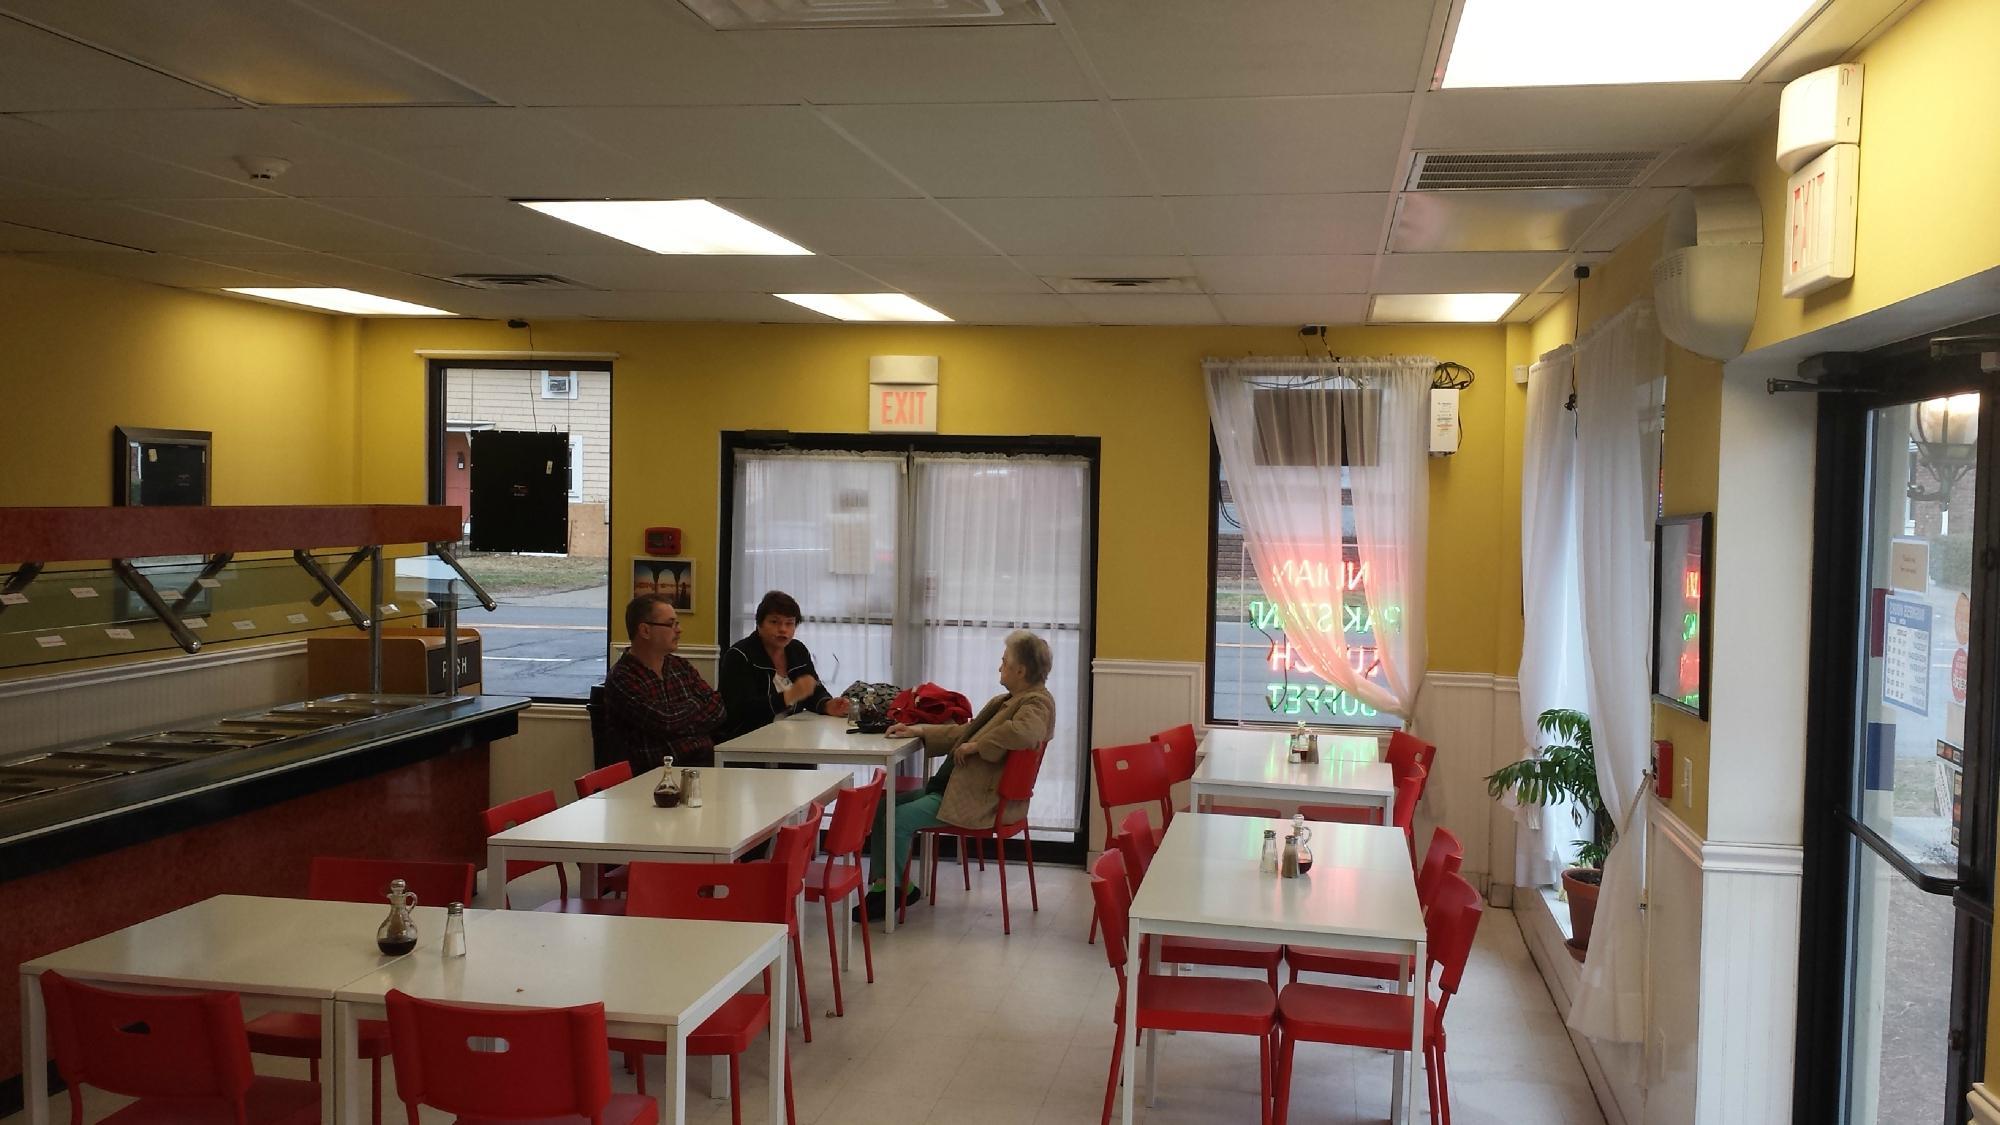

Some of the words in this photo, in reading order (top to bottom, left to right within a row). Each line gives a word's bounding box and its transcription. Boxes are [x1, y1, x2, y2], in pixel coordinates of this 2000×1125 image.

[1791, 172, 1825, 273] EXIT
[881, 392, 927, 425] EXIT
[442, 656, 468, 679] PSH
